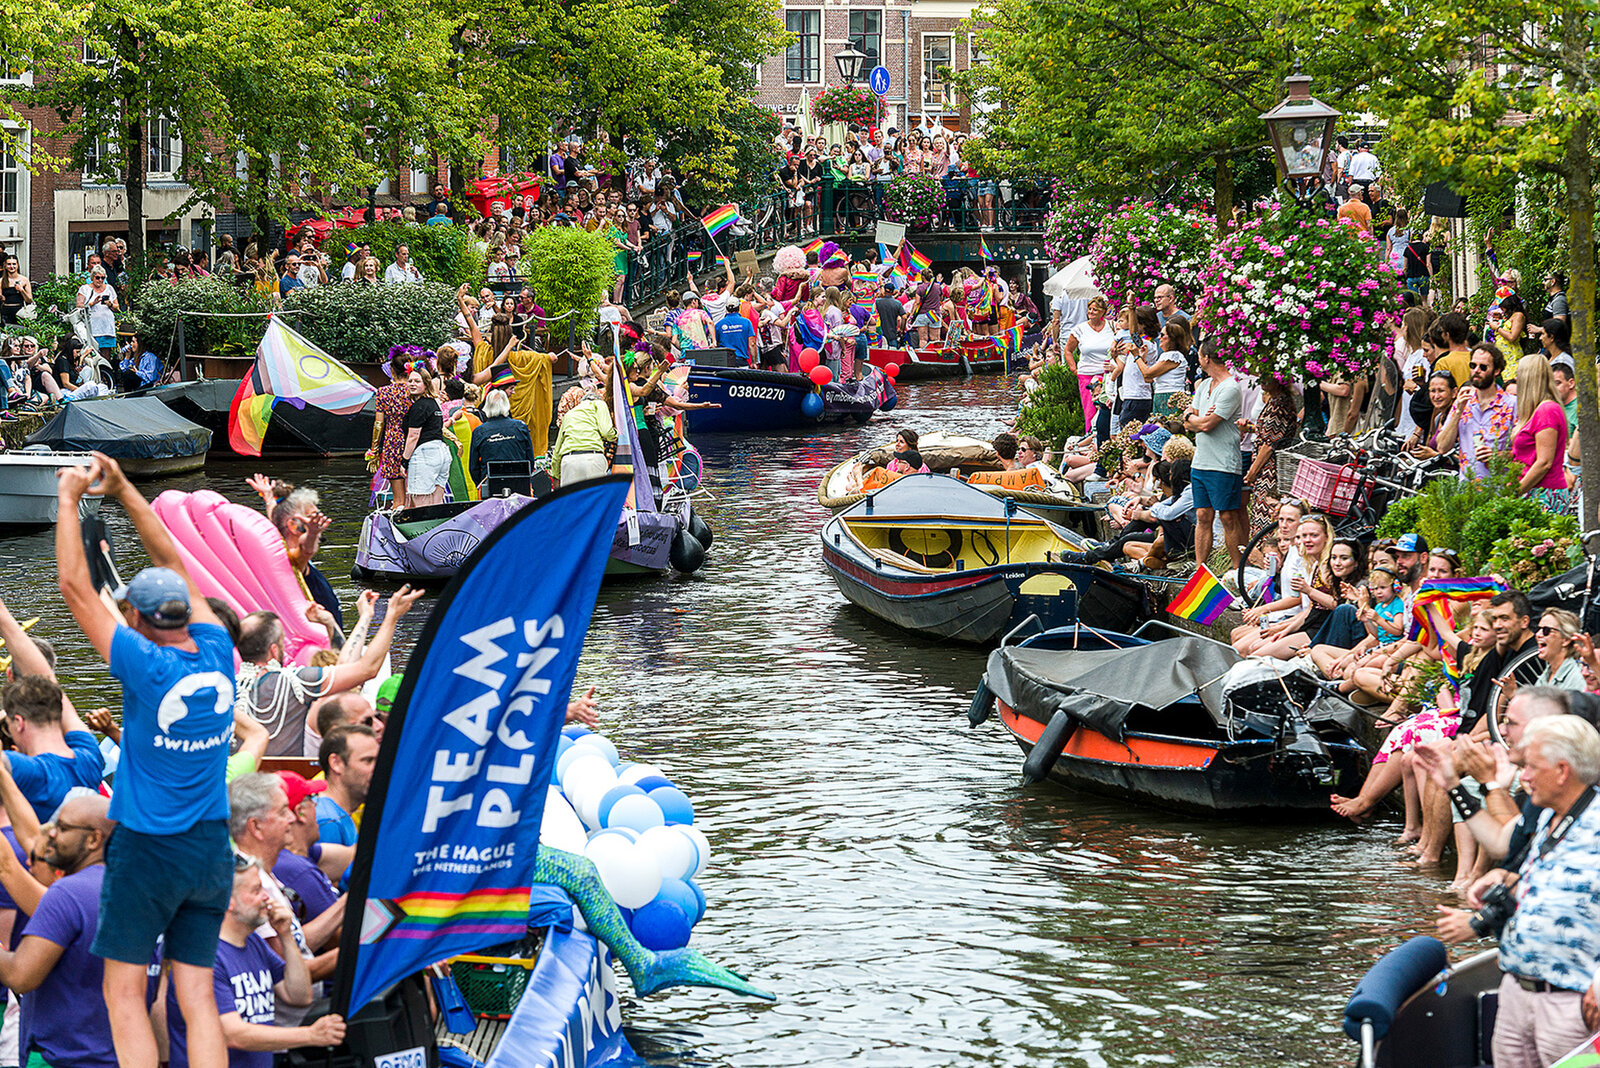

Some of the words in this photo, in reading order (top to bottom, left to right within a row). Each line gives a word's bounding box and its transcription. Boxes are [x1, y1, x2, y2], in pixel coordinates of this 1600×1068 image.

[728, 385, 785, 400] 03802270
[421, 616, 516, 833] TEAM
[414, 844, 450, 866] THE
[452, 842, 516, 862] HAGUE
[412, 863, 432, 877] THE
[433, 858, 512, 875] NETHERLANDS
[230, 969, 273, 998] TEAM
